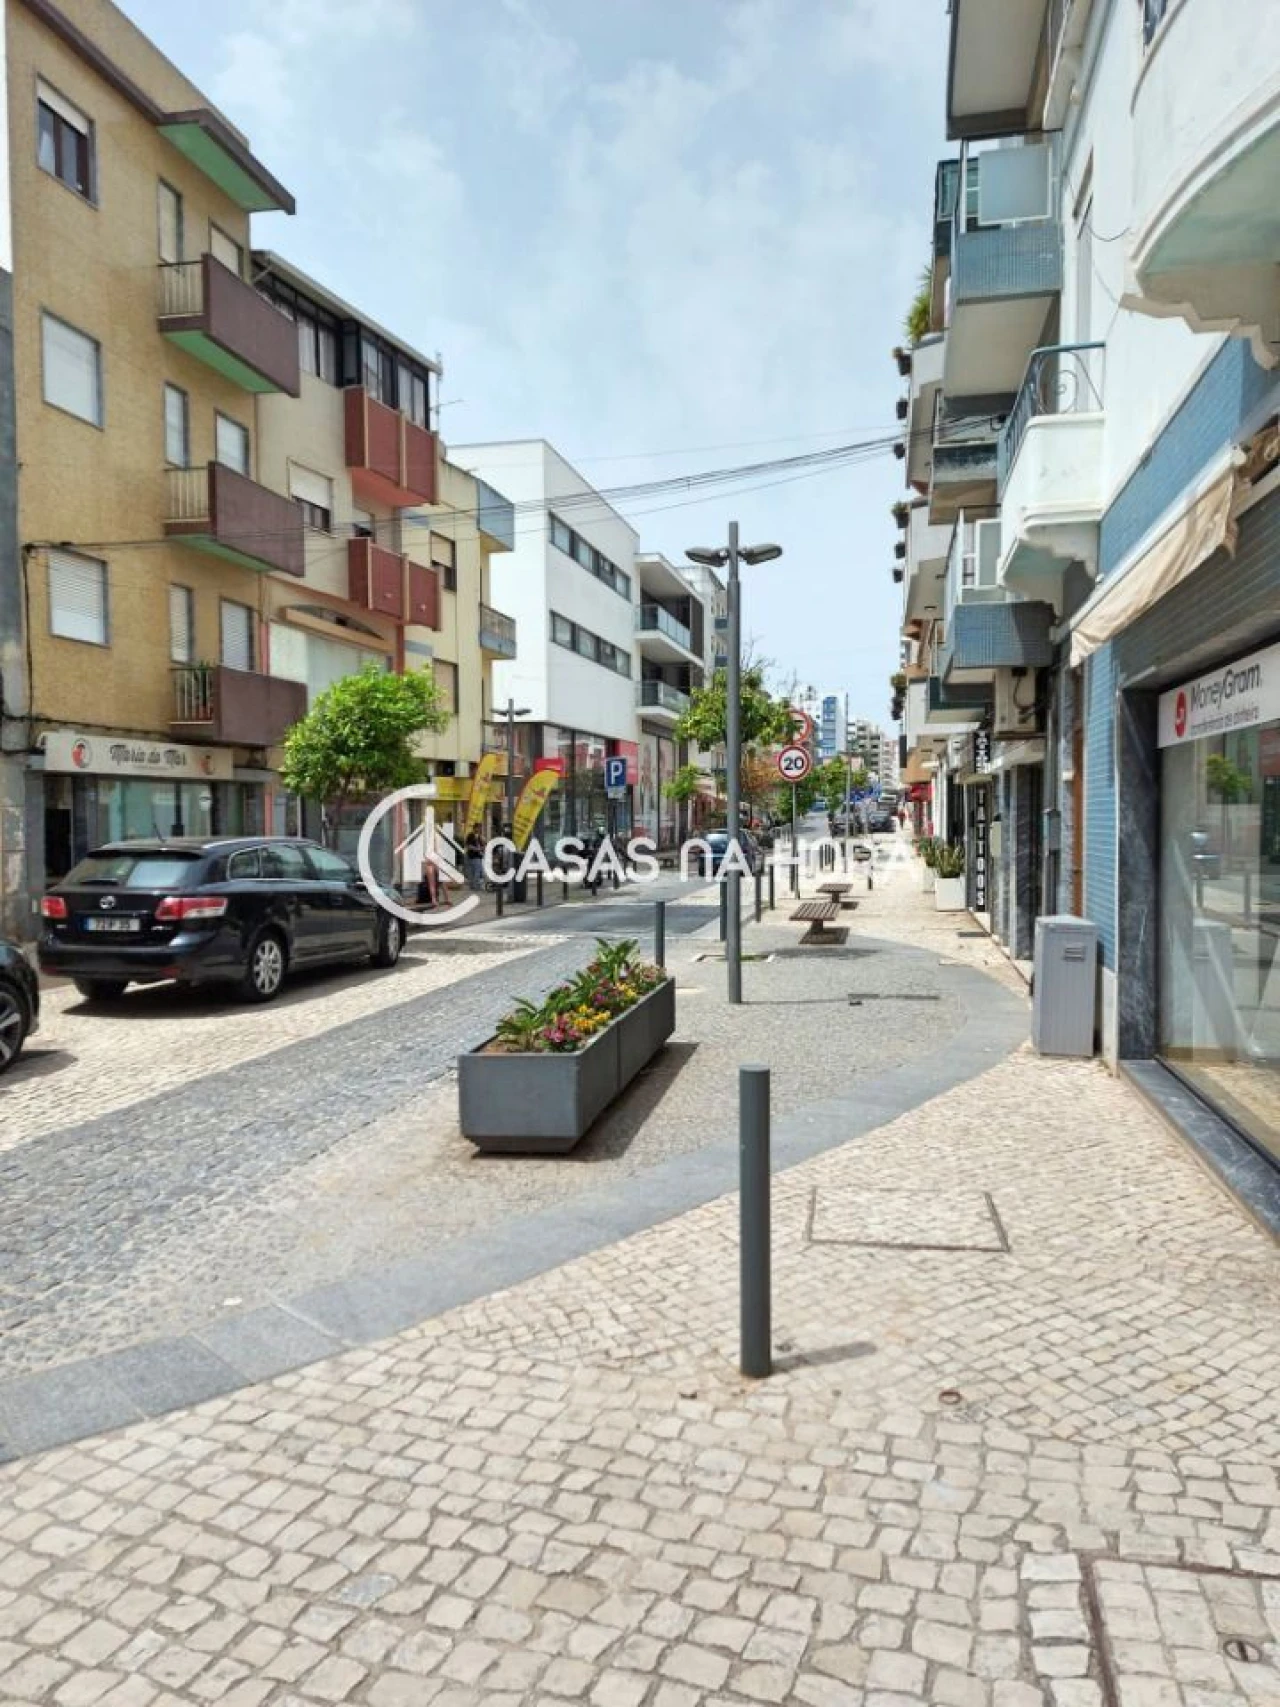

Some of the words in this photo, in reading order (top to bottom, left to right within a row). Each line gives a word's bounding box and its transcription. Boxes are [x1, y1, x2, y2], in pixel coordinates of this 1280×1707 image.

[1190, 663, 1260, 711] MoneyGram
[610, 761, 623, 785] P
[783, 756, 804, 771] 20
[975, 788, 986, 906] TATTOOS
